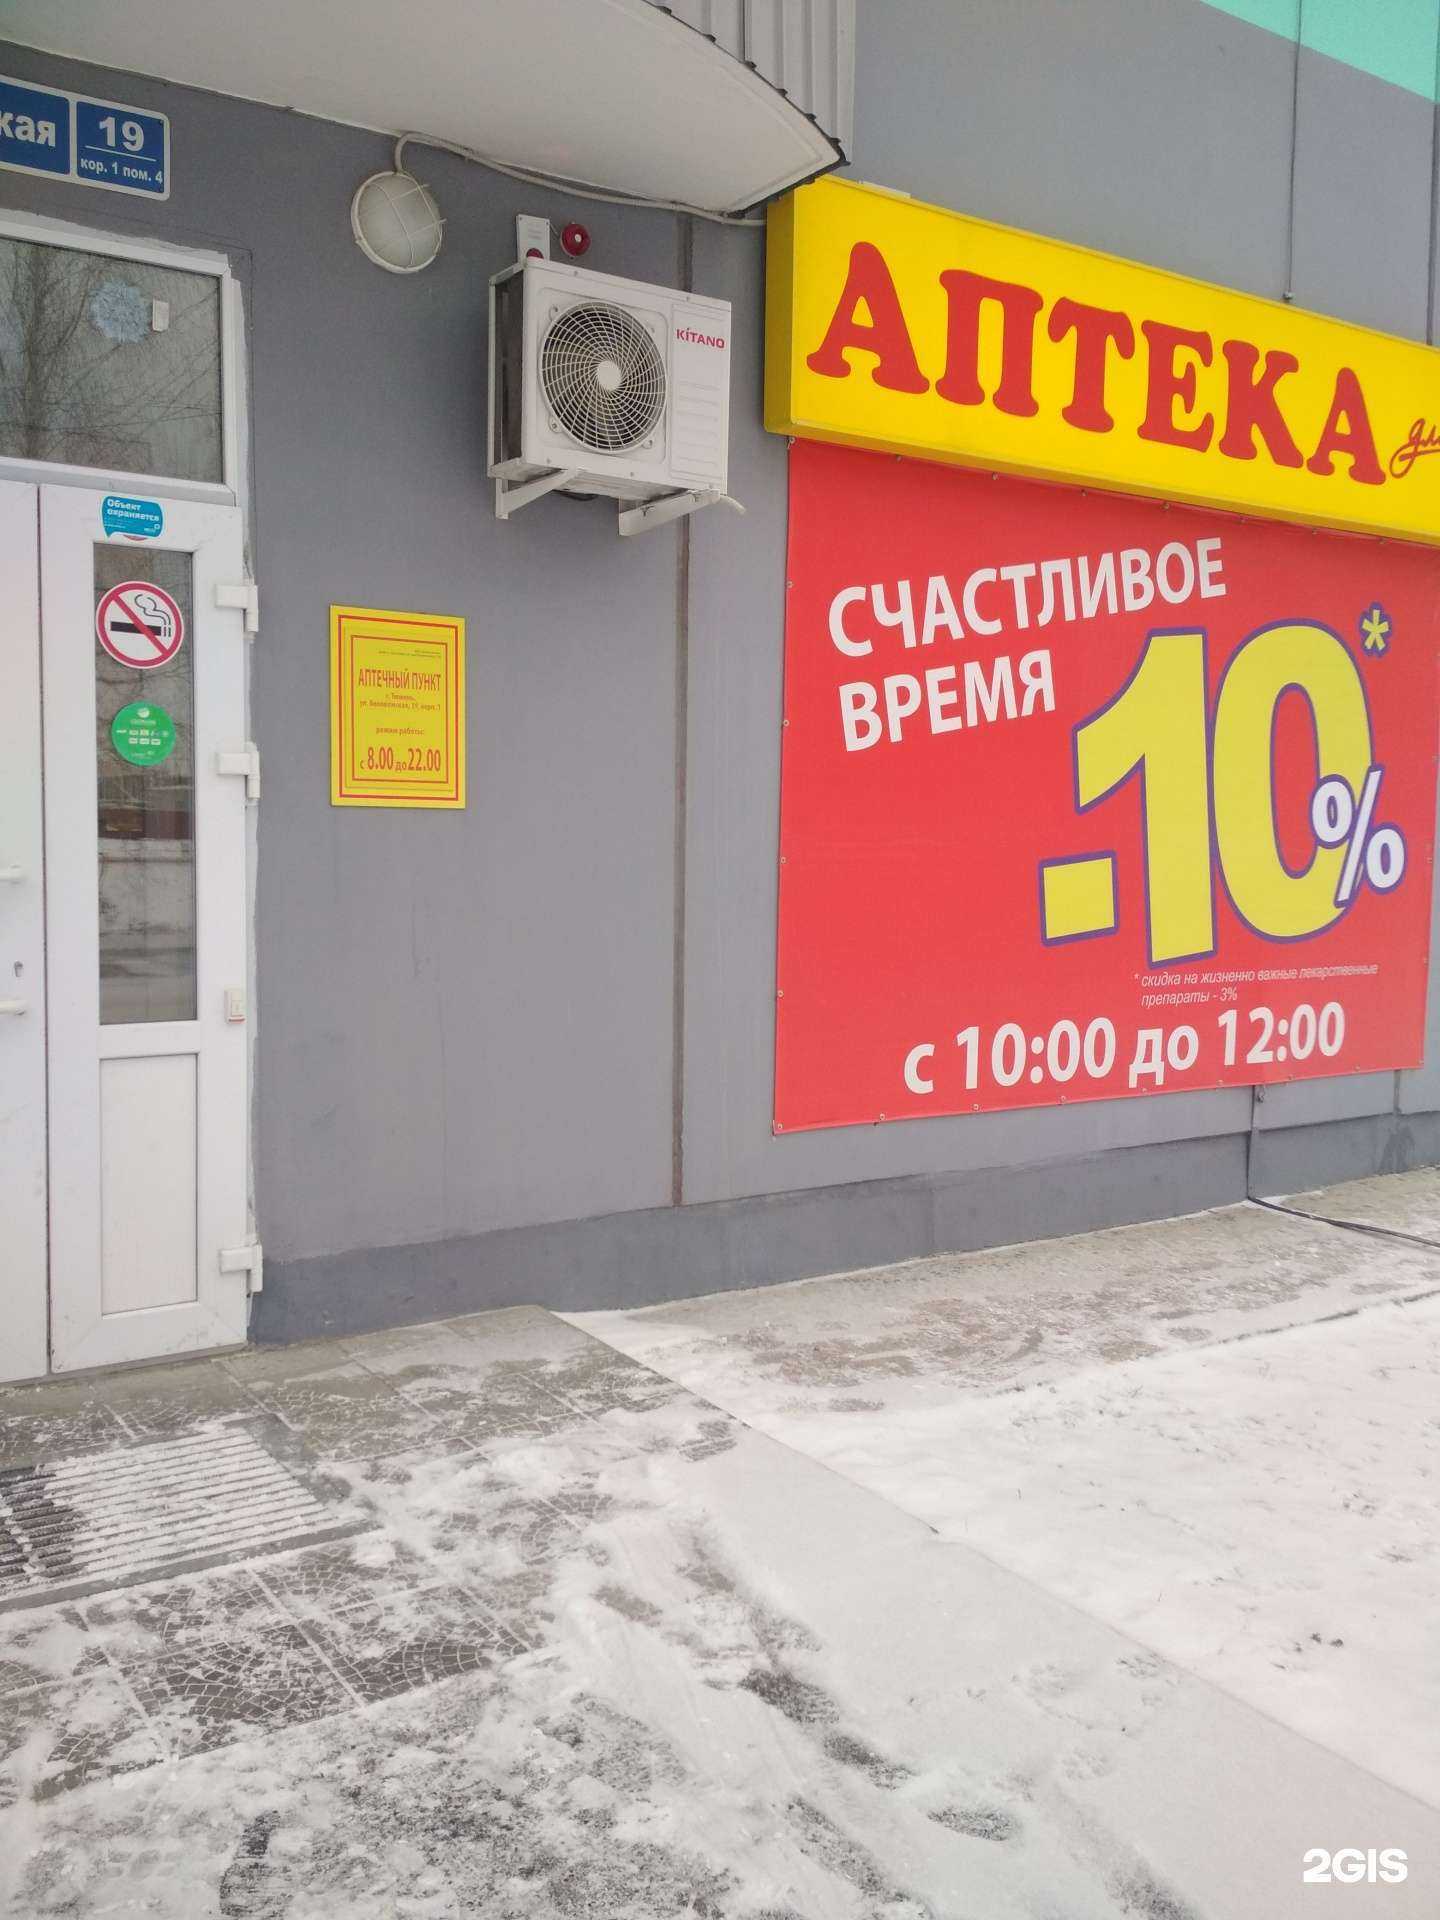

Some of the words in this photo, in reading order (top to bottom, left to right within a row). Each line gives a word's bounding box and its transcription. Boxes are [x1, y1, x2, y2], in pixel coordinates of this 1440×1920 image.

[99, 117, 144, 151] 19
[80, 158, 107, 174] кор.
[112, 162, 118, 174] 1
[123, 168, 152, 182] пом.
[155, 171, 163, 184] 4
[806, 241, 1387, 486] АПТЕКА
[107, 498, 141, 511] Объект
[107, 508, 160, 521] охраняется
[828, 537, 1227, 658] СЧАСТЛИВОЕ
[358, 668, 410, 689] АПТЕЧНЫЙ
[411, 672, 442, 691] ПУНКТ
[838, 649, 1056, 752] ВРЕМЯ
[367, 747, 394, 770] 8.00
[407, 748, 441, 772] 22.00
[1141, 972, 1180, 988] скидка
[1183, 974, 1198, 984] на
[1200, 970, 1255, 984] жизненно
[1257, 968, 1298, 980] важные
[1141, 991, 1210, 1008] препараты
[1220, 986, 1238, 1002] 3%
[956, 1016, 1116, 1090] 10:00
[1128, 1025, 1199, 1088] до
[1217, 1001, 1345, 1066] 12:00
